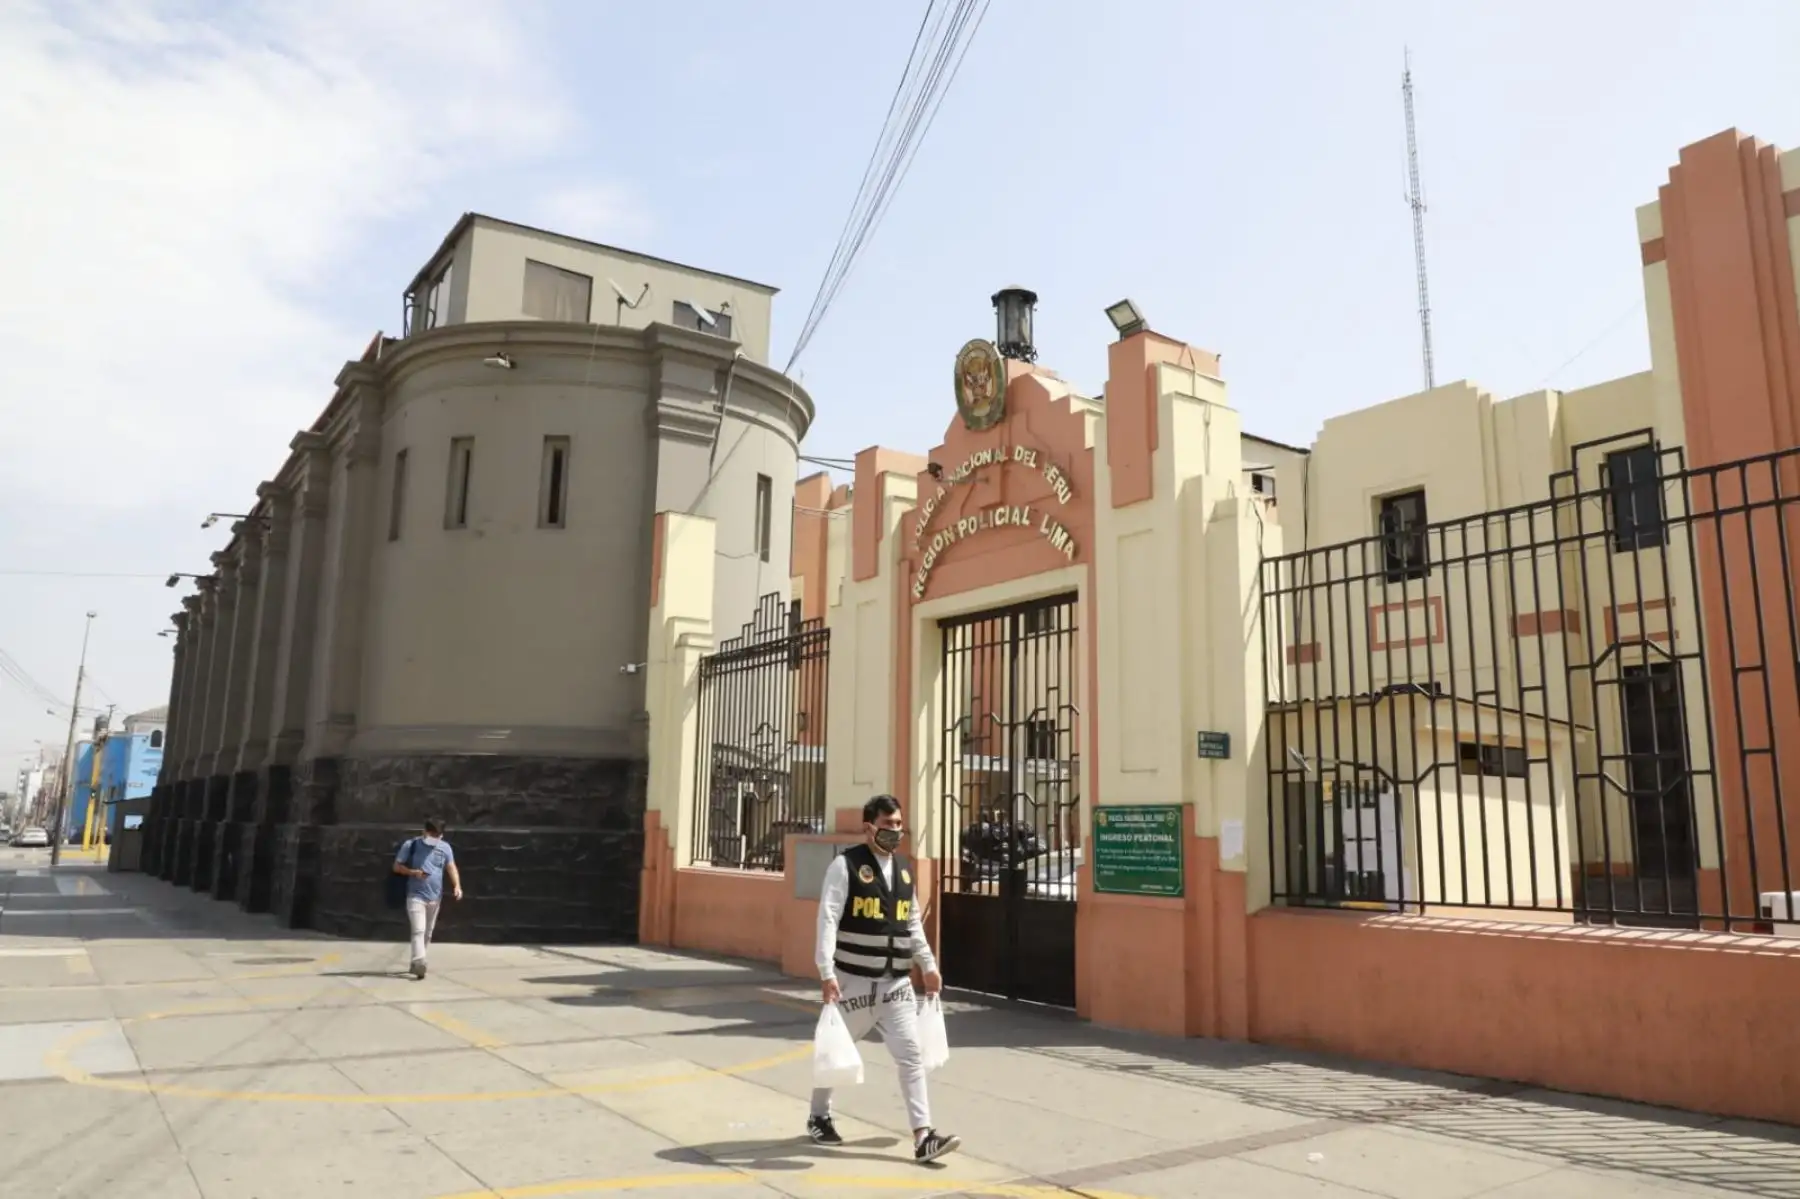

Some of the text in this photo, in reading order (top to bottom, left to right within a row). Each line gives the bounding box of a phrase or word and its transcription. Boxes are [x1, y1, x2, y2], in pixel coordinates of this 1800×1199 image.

[1013, 445, 1037, 469] DEL
[1042, 461, 1073, 505] PERU
[912, 505, 1076, 599] REGION POLICIAL LIMA
